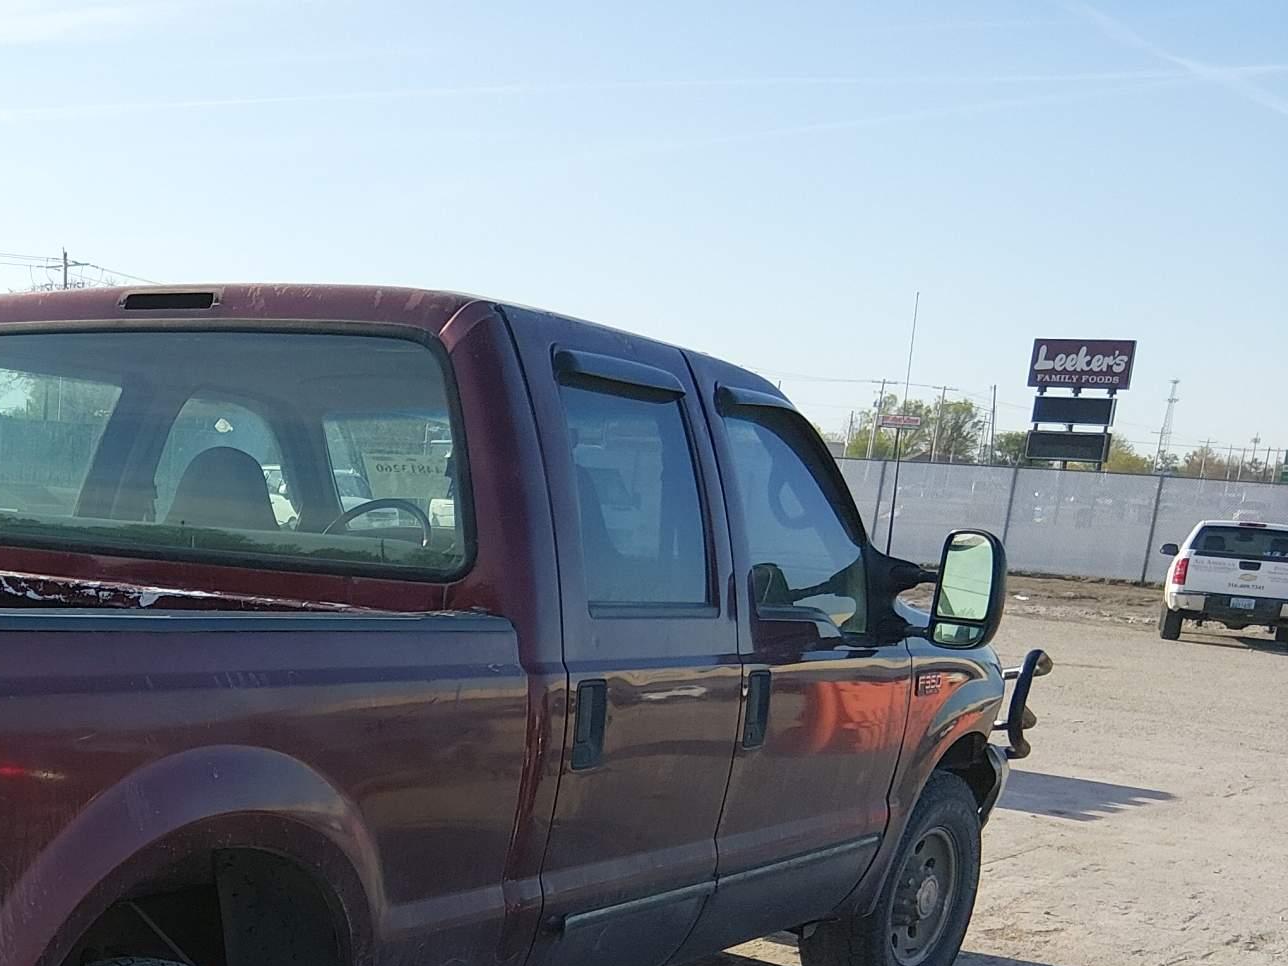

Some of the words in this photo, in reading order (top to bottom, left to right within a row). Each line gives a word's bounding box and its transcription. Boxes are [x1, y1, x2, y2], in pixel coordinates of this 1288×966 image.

[1034, 344, 1128, 373] Leeker's
[1036, 373, 1078, 383] FAMILY
[1082, 375, 1120, 384] FOODS
